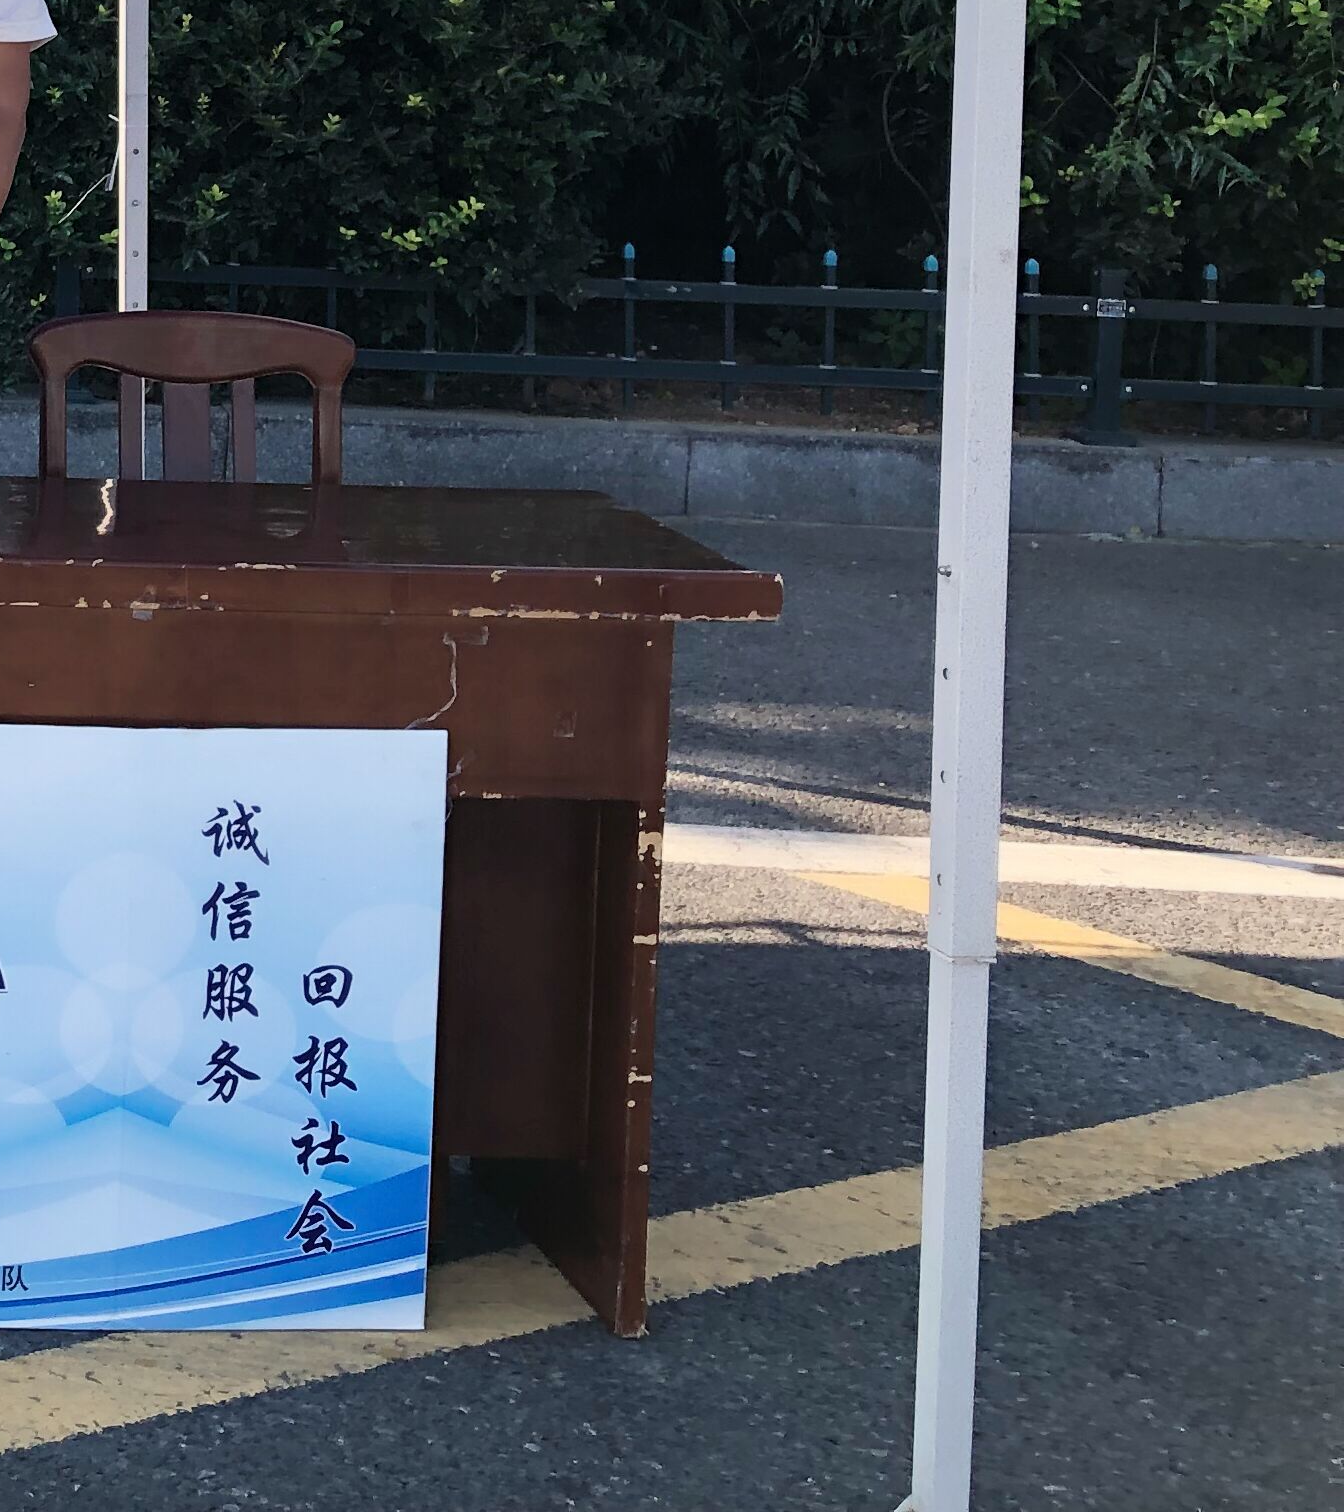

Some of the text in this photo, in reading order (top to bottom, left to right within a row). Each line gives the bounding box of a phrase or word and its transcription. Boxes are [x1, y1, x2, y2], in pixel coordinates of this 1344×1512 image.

[196, 799, 271, 1104] 诚信服务
[286, 964, 358, 1255] 回报社会
